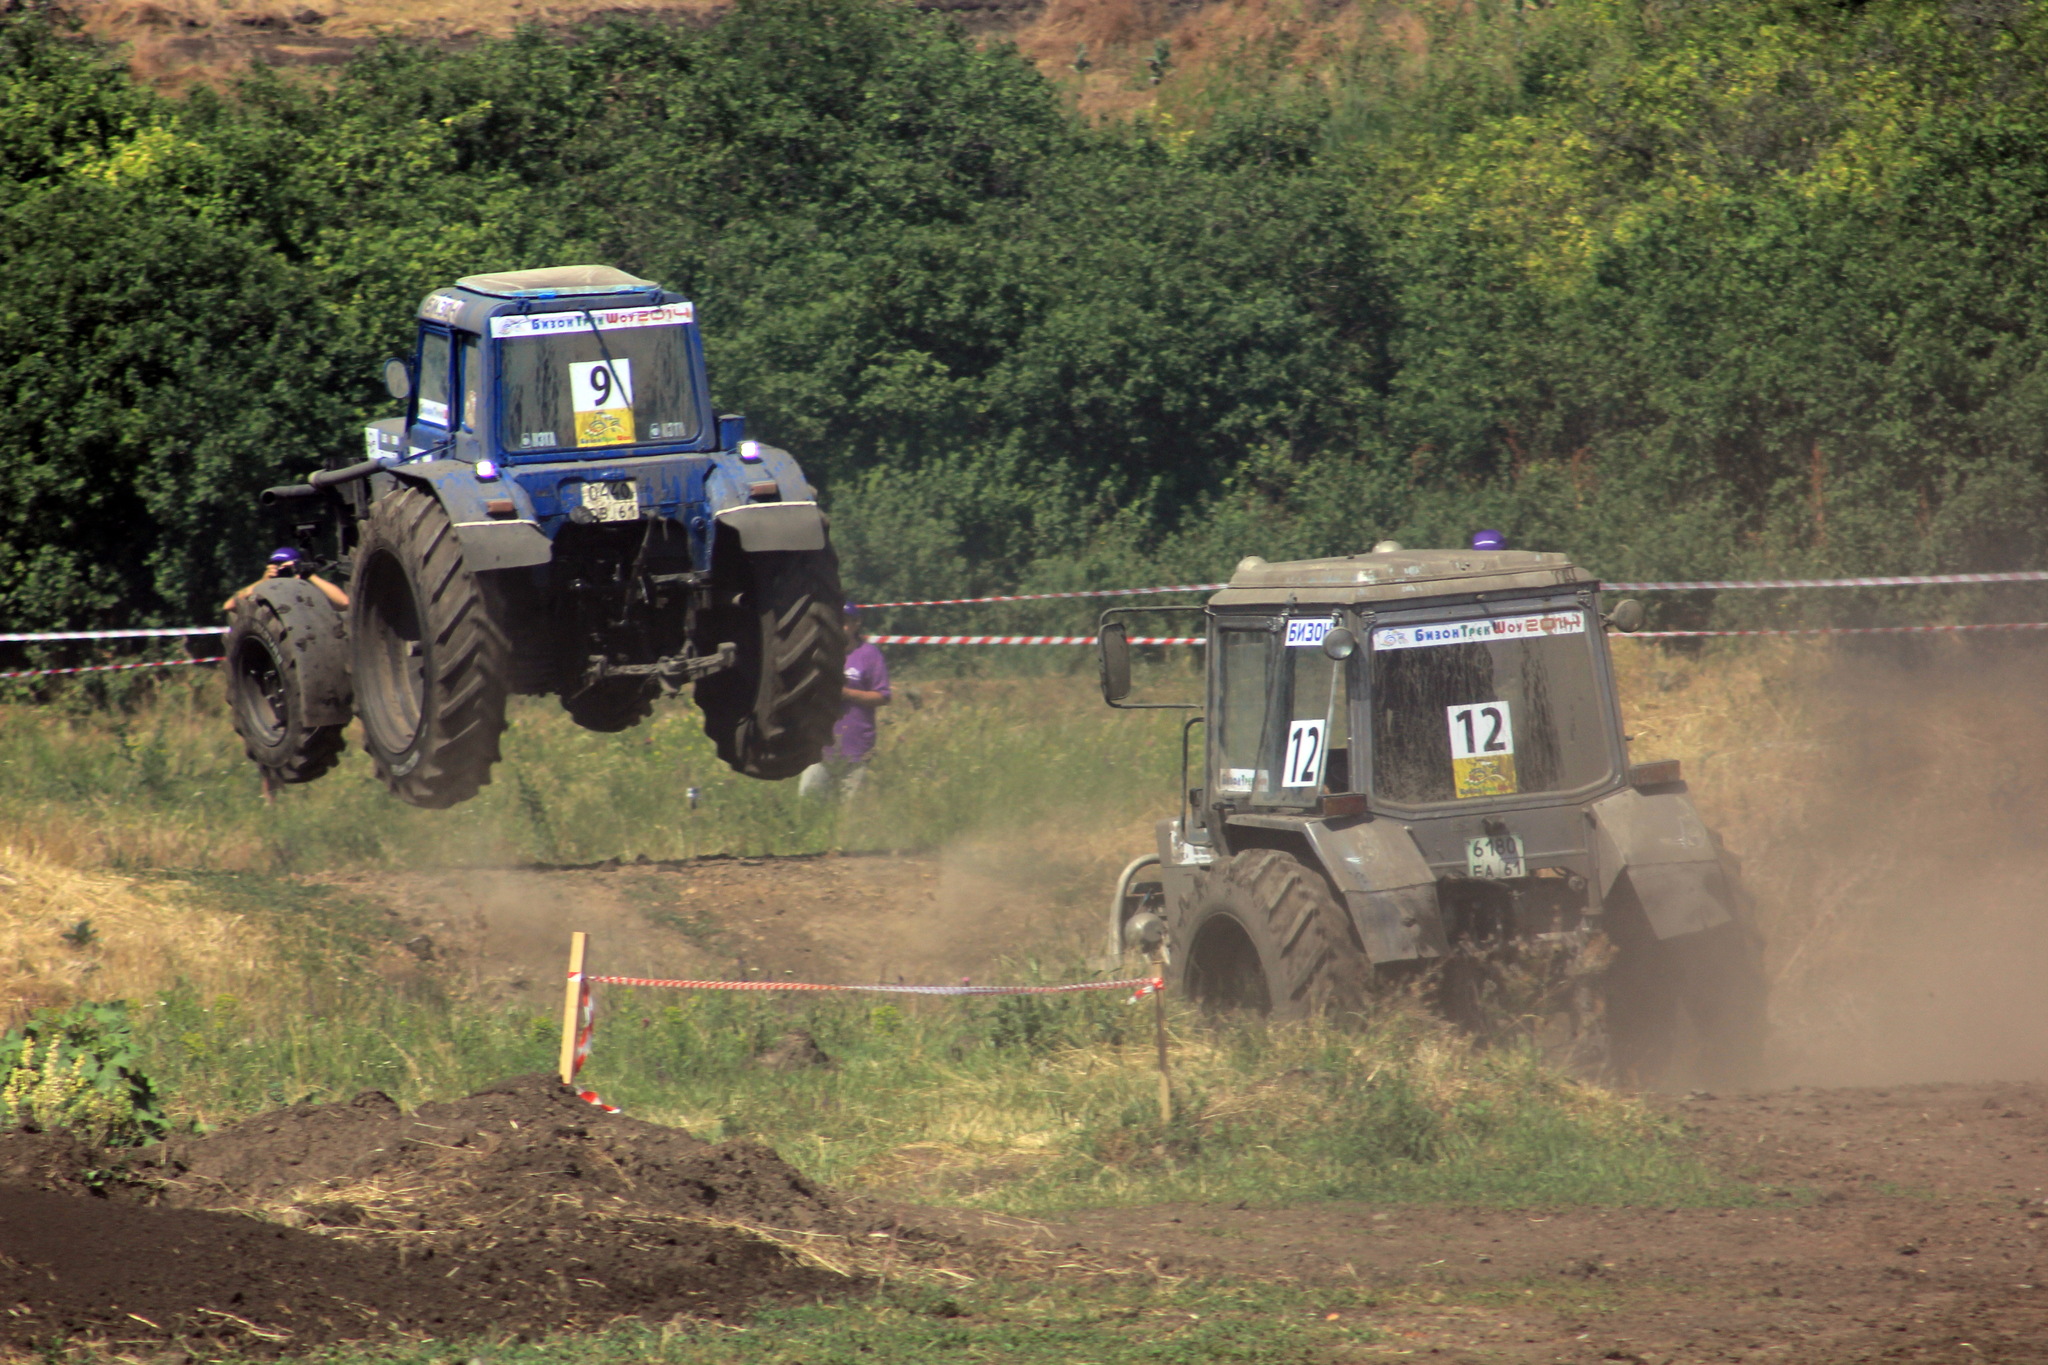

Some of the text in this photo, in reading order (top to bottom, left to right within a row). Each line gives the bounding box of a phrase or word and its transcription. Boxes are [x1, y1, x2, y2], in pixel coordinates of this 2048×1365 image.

[590, 365, 611, 407] 9
[618, 505, 636, 519] 61
[1455, 706, 1506, 754] 12
[1291, 726, 1319, 783] 12
[1473, 837, 1517, 858] 6180
[1503, 860, 1522, 877] 61
